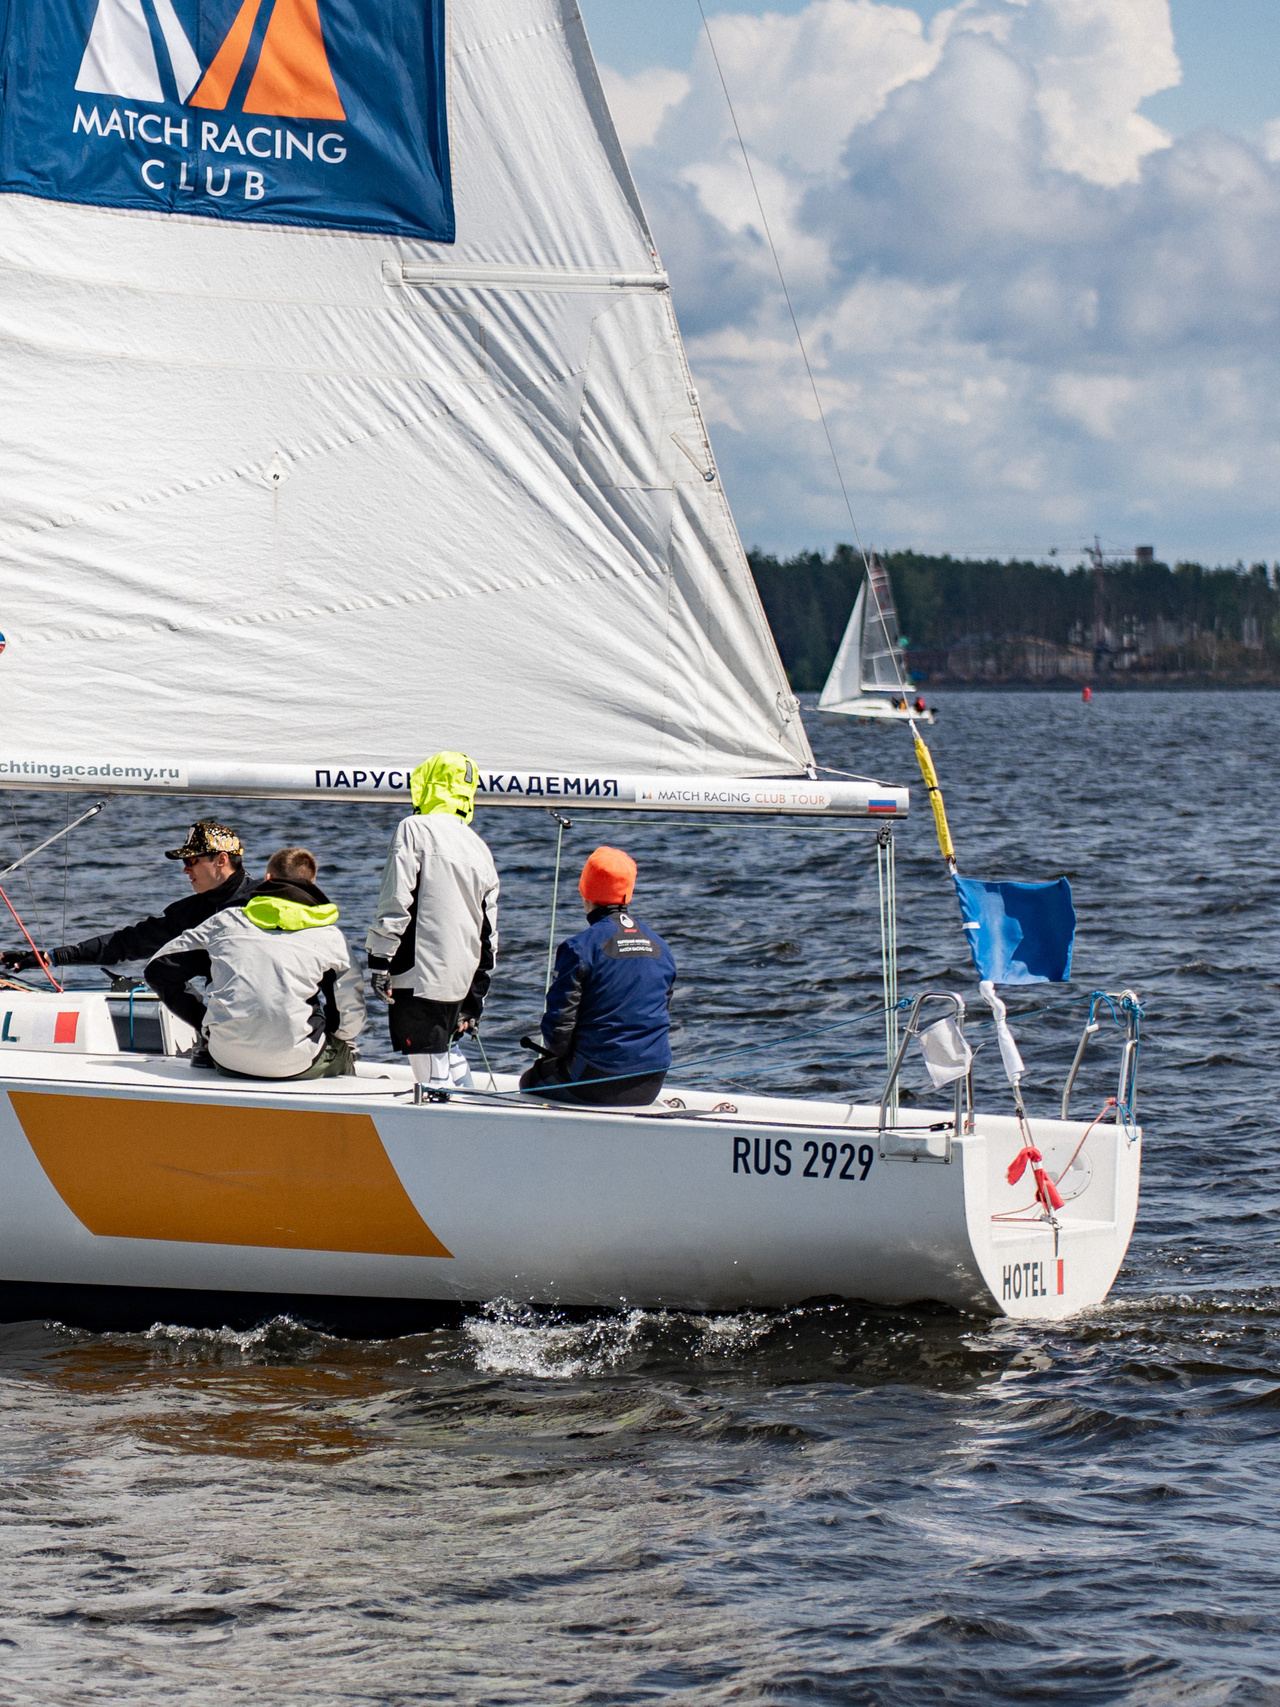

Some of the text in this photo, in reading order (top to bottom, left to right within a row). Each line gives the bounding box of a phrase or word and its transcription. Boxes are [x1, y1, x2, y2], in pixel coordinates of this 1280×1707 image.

[72, 104, 348, 164] MATCH RACING
[141, 159, 265, 201] CLUB
[314, 770, 412, 790] ПАРУС
[658, 791, 825, 805] MATCH RACING CLUB TOUR
[732, 1137, 874, 1181] RUS 2929
[1002, 1262, 1047, 1301] HOTEL
